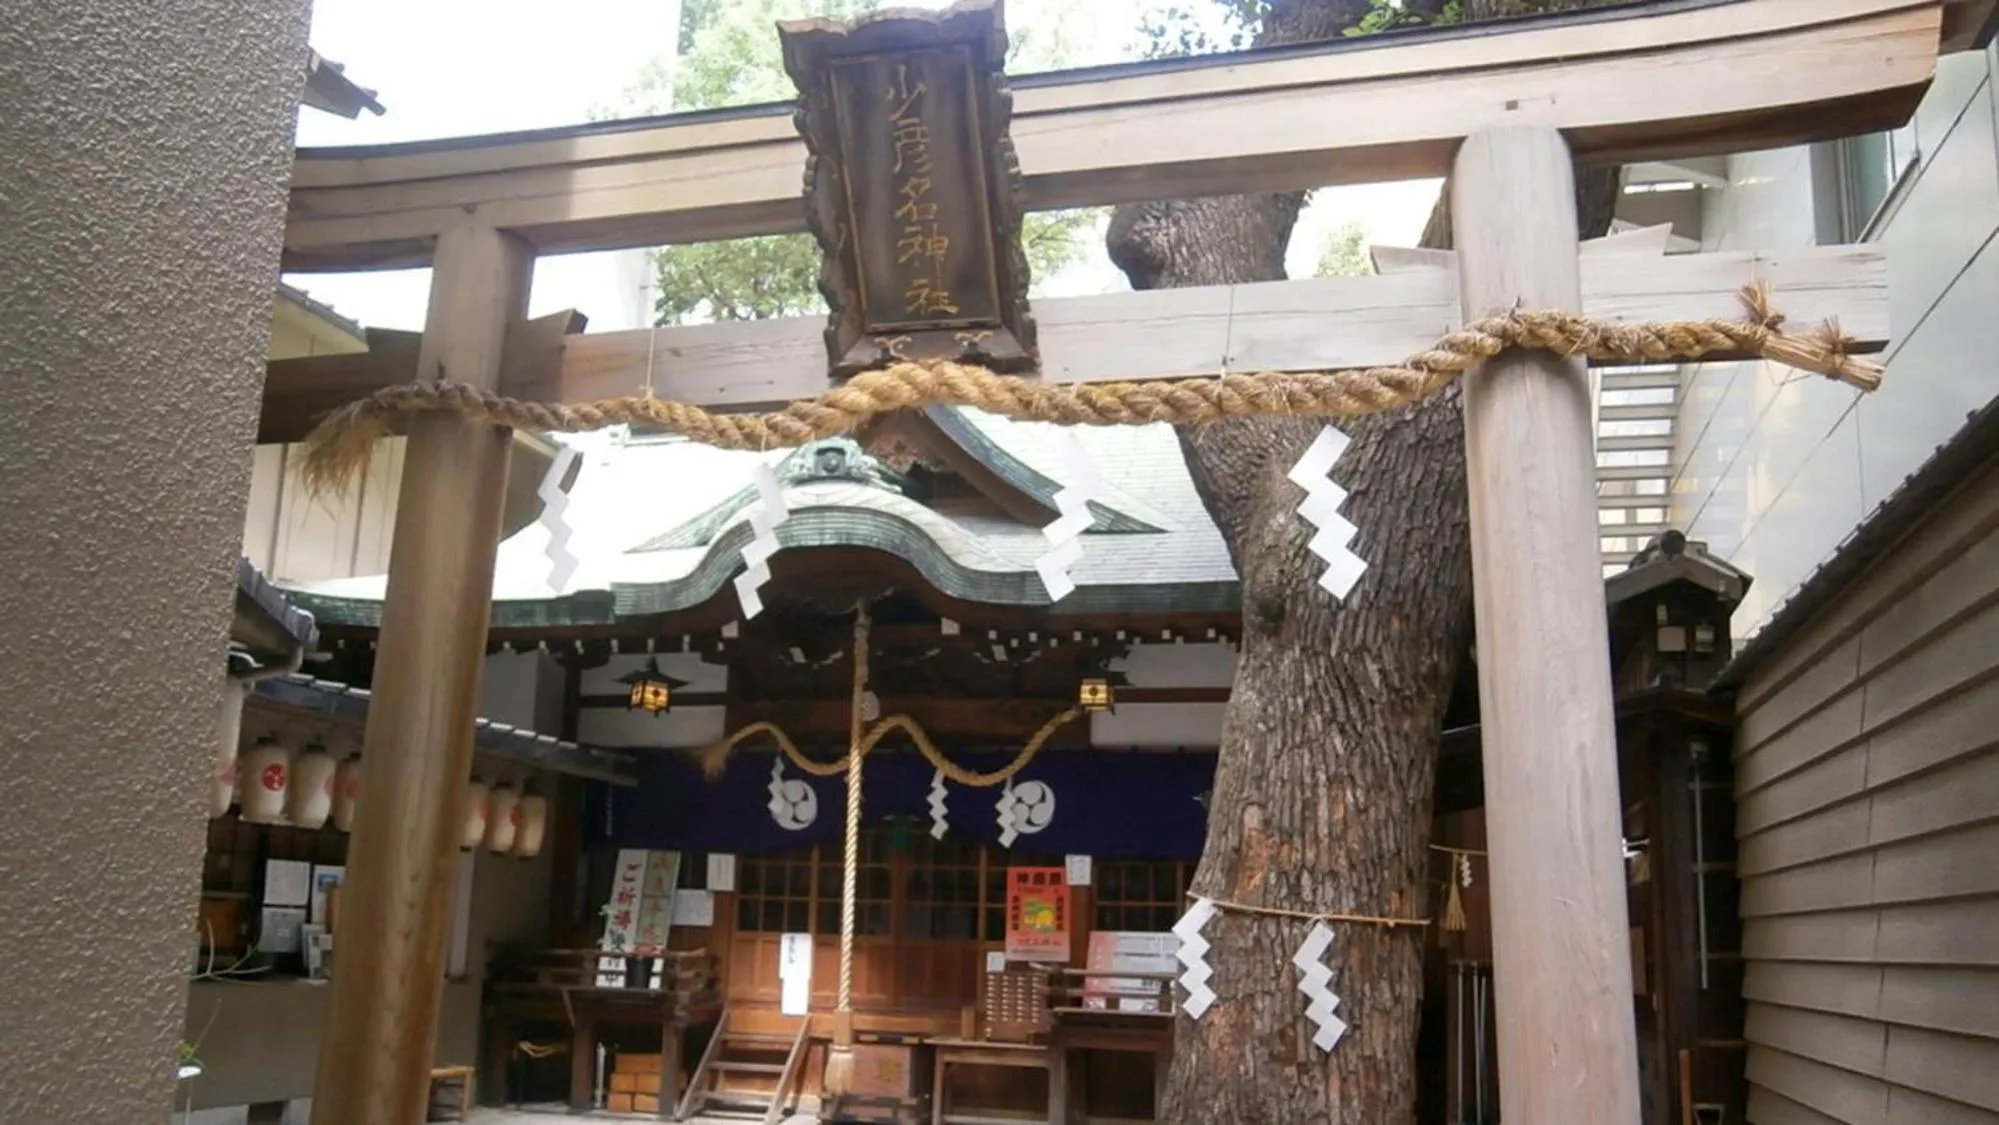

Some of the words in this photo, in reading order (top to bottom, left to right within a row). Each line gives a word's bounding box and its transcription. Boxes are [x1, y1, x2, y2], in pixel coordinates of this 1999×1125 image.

[888, 64, 958, 314] 少彦名神社
